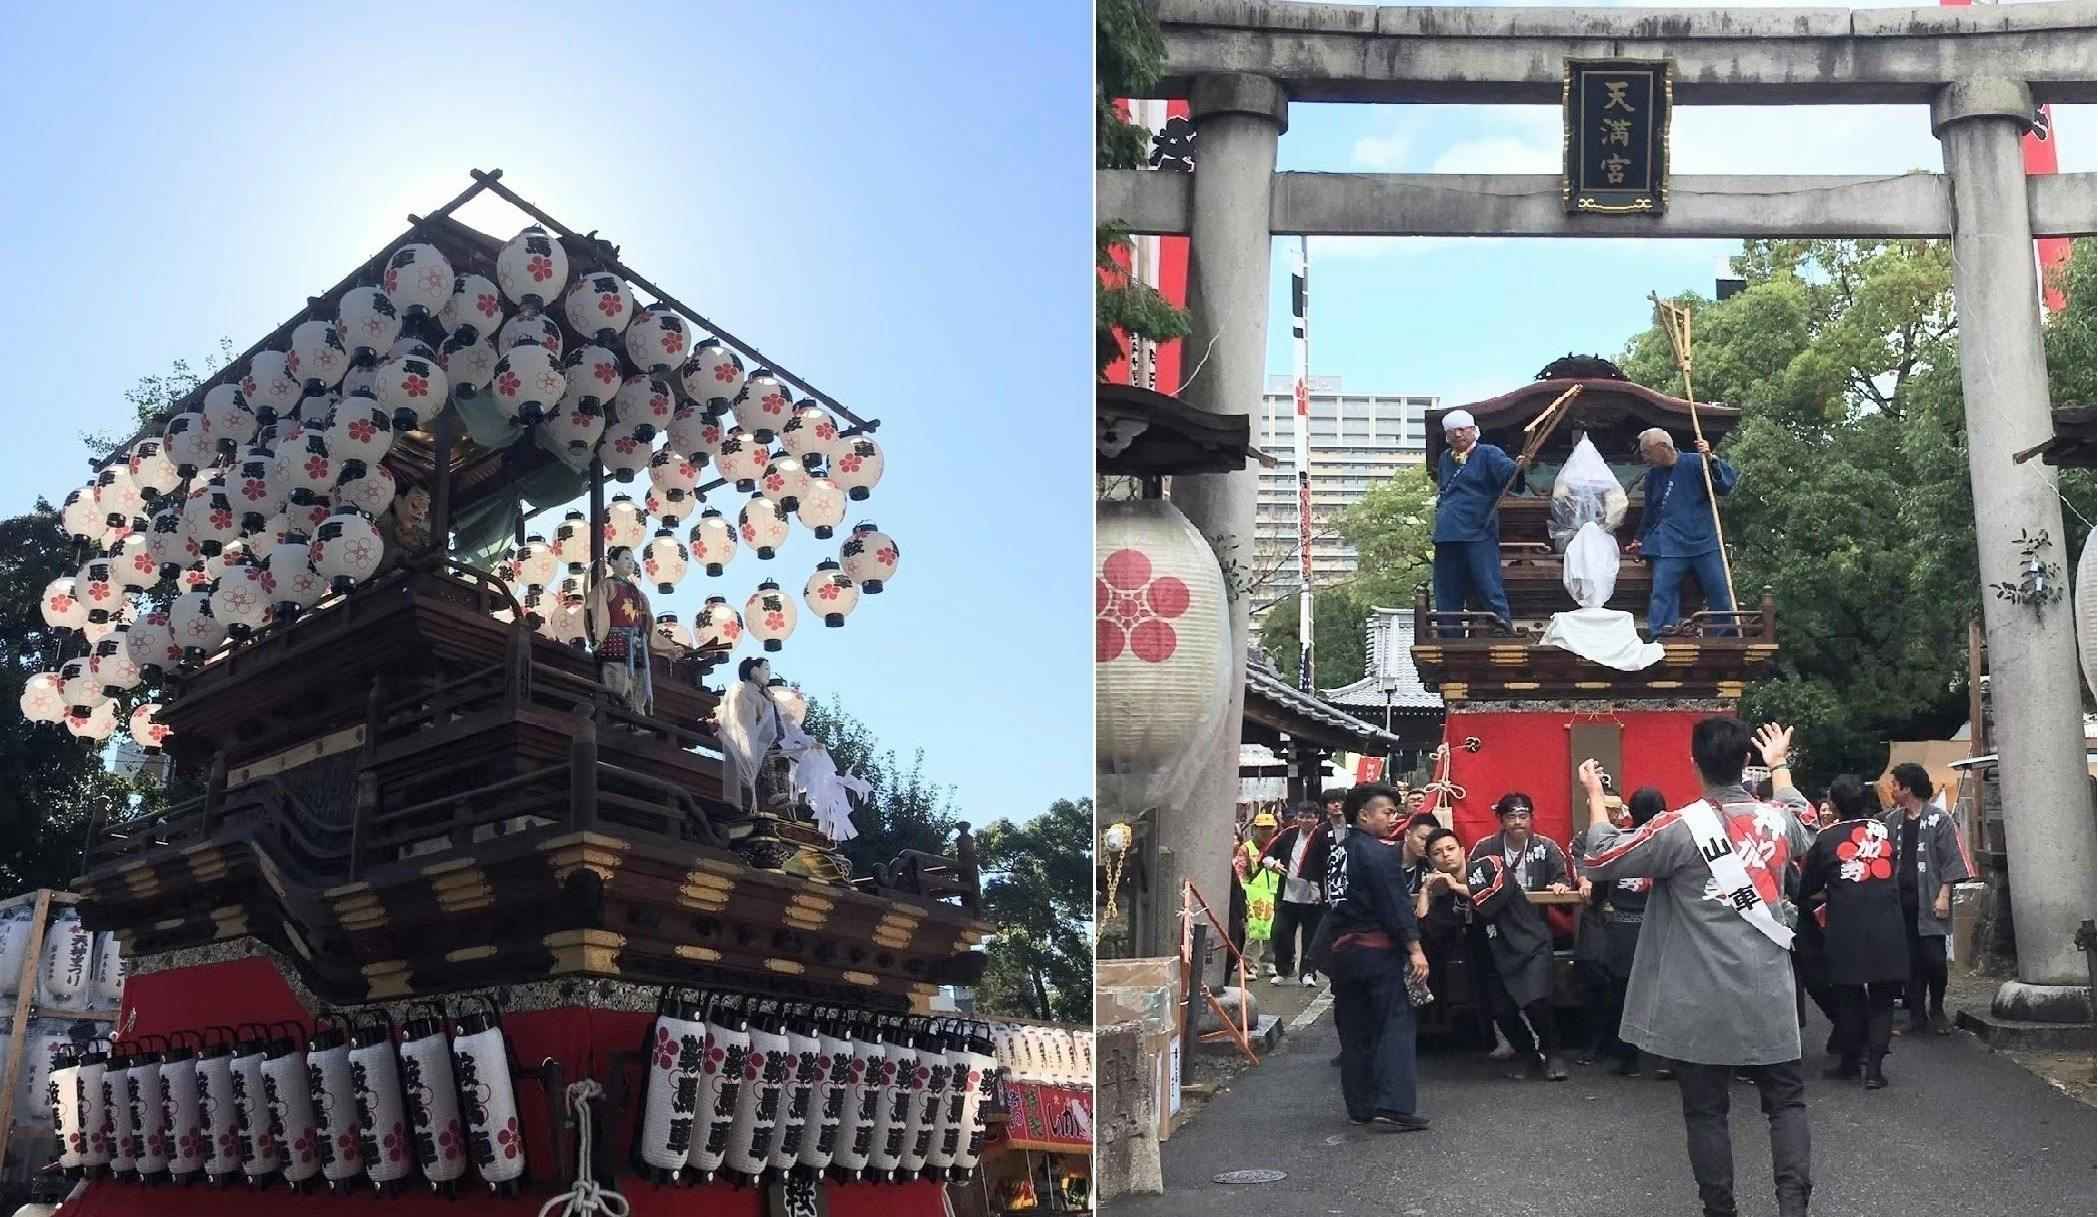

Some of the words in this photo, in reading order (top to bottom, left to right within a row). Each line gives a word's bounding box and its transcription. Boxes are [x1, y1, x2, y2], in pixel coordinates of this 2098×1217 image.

[1601, 81, 1636, 185] 天満宮
[843, 539, 864, 557] 鞍
[88, 564, 109, 582] 馬
[762, 595, 782, 612] 馬
[1703, 837, 1761, 911] 山車
[667, 1034, 705, 1156] 鞍馬車
